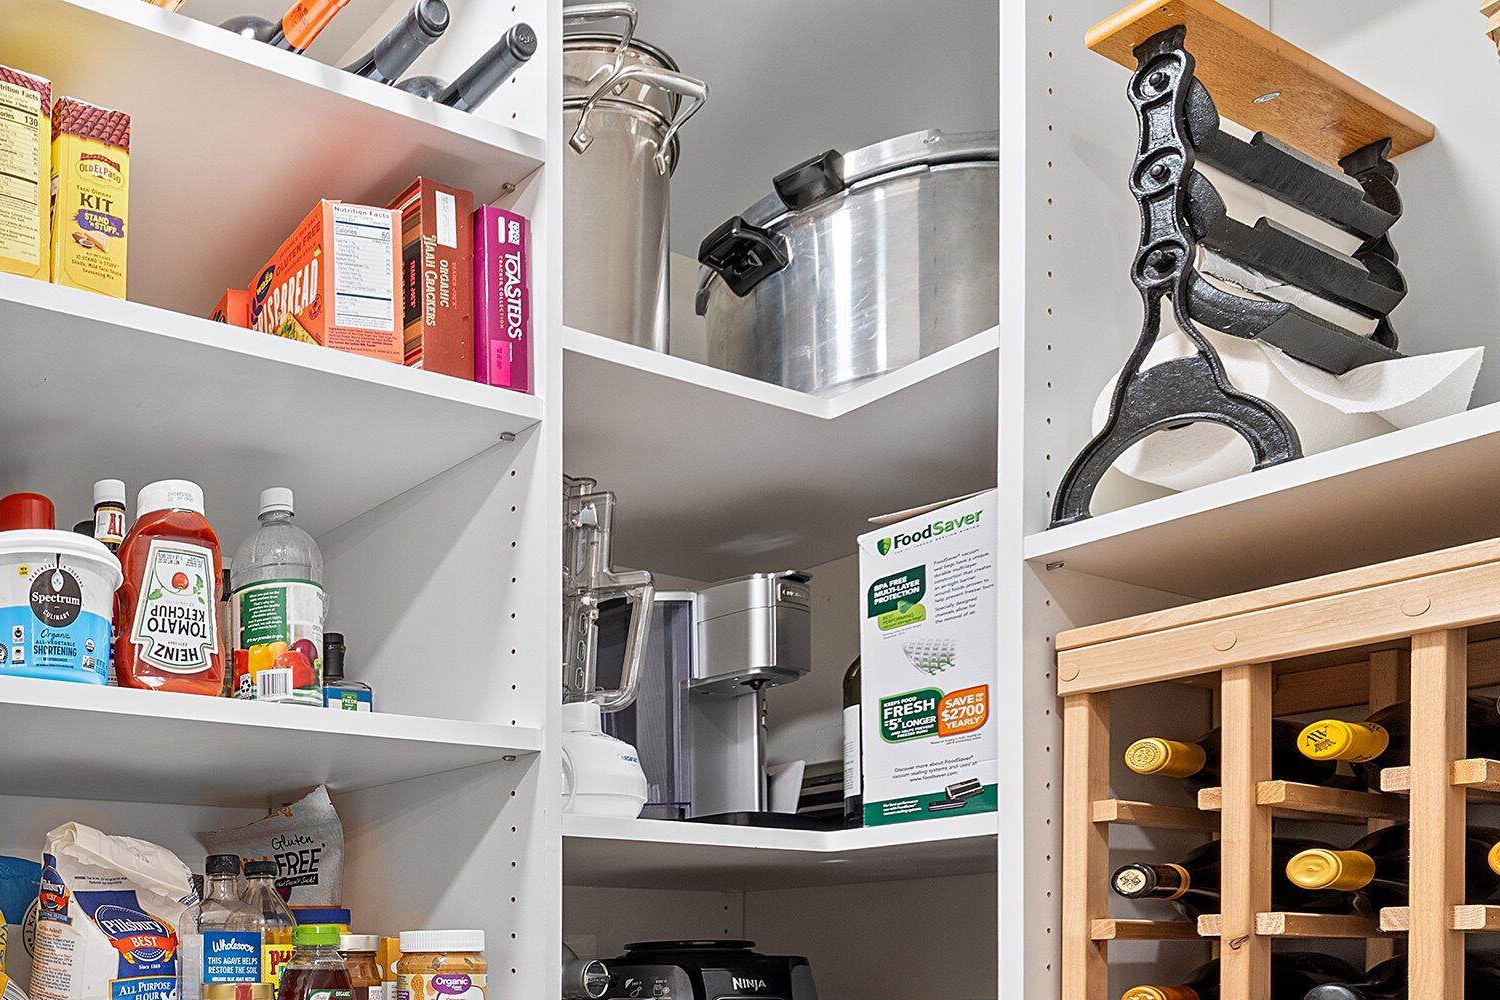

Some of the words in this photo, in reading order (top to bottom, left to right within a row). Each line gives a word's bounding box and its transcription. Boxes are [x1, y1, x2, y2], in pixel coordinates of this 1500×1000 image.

[22, 89, 38, 100] Facts
[25, 116, 38, 126] 130
[80, 193, 113, 212] KIT
[85, 212, 109, 224] STAND
[335, 206, 367, 215] Nutrition
[369, 211, 389, 219] Facts
[440, 260, 449, 308] ORGANIC
[425, 271, 437, 326] CRACKERS
[505, 251, 522, 340] TOASTEDS
[894, 510, 983, 549] FoodSaver
[874, 579, 920, 598] MULTI-LAYER
[889, 576, 907, 587] FREE
[32, 591, 80, 605] Spectrum
[874, 587, 920, 605] PROTECTION
[42, 609, 70, 620] CULINARY
[150, 605, 205, 621] KETCHUP
[41, 629, 71, 640] Organic
[147, 617, 207, 639] TOMATO
[33, 645, 77, 657] SHORTENING
[154, 643, 199, 662] HEINZ
[884, 698, 935, 720] FRESH
[945, 695, 973, 708] SAVE
[942, 703, 984, 722] $2700
[902, 716, 936, 729] LONGER
[272, 834, 314, 851] Gluten
[274, 848, 321, 876] FREE
[101, 919, 162, 934] Pillsbury
[131, 936, 158, 947] BEST
[212, 938, 254, 953] Wholesome
[208, 957, 222, 965] THIS
[223, 957, 240, 965] AGAVE
[208, 966, 234, 974] RESTORE
[235, 966, 245, 974] THE
[246, 966, 257, 974] SOIL
[119, 985, 137, 996] ALL
[138, 982, 171, 992] PURPOSE
[436, 977, 468, 987] Organic
[732, 977, 766, 992] NINJA
